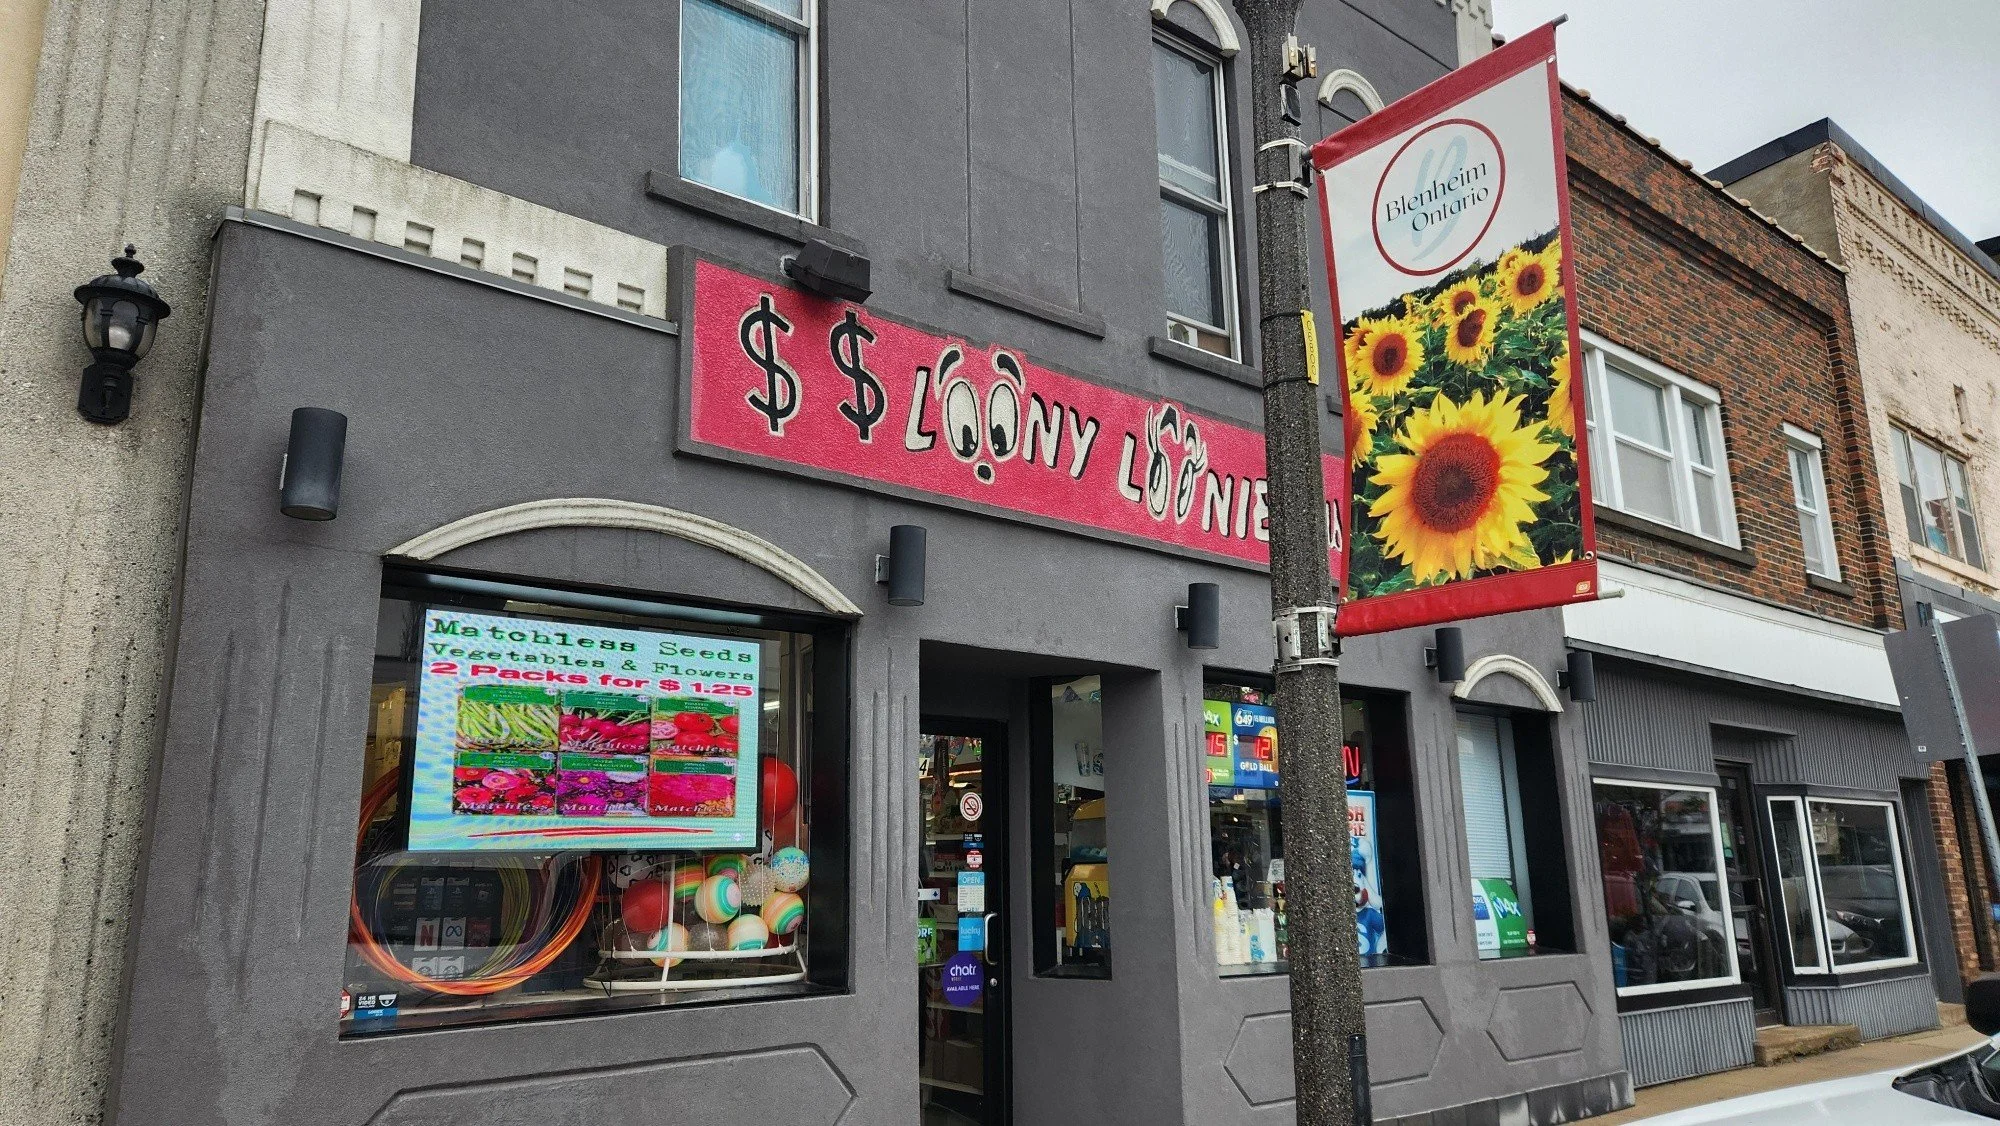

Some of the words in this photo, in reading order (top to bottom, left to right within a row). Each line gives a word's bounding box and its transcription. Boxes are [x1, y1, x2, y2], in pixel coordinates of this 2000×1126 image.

[1386, 163, 1487, 222] Blenheim
[1412, 187, 1489, 231] Ontario
[904, 364, 1101, 480] LOONY
[431, 618, 636, 652] Matchless
[659, 641, 752, 663] Seeds
[428, 643, 605, 668] Vegetables
[621, 659, 637, 671] &
[652, 662, 754, 681] Flowers
[430, 662, 458, 675] 2
[470, 664, 589, 684] Packs
[598, 674, 650, 688] for
[658, 679, 681, 692] $
[690, 682, 753, 697] 1.25
[567, 739, 645, 751] Matchless
[656, 742, 733, 753] Matchless
[1256, 738, 1271, 759] 12
[1240, 761, 1257, 771] GOLD
[1259, 763, 1274, 772] BALL
[458, 801, 550, 812] Matchless
[654, 804, 731, 813] Matchless
[962, 876, 980, 884] OPEN
[1492, 896, 1521, 919] MAX
[960, 926, 981, 936] lucky
[950, 963, 976, 977] chatr
